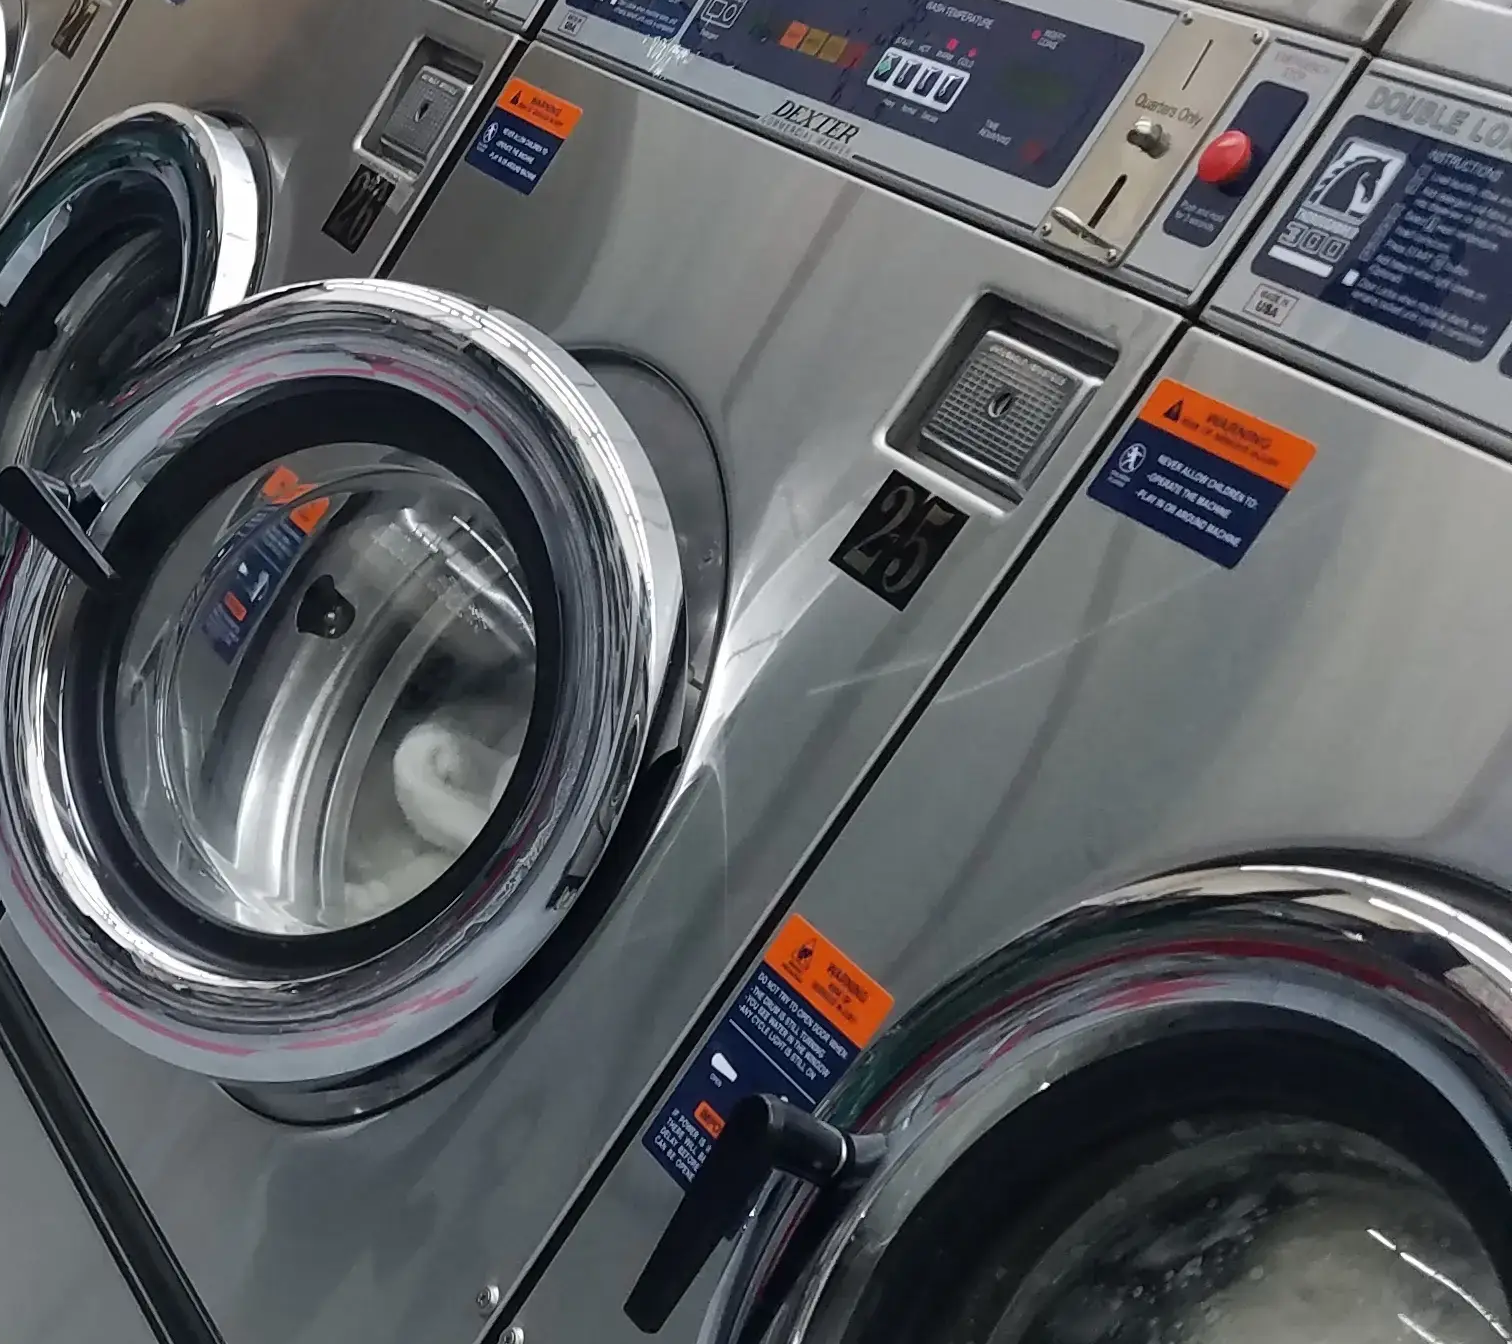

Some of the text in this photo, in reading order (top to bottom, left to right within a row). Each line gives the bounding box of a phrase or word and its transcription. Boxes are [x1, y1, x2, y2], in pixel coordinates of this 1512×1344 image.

[945, 6, 996, 30] TEMPERATURE
[771, 99, 861, 144] DEXTER
[1134, 92, 1204, 129] Quarters Only
[1366, 86, 1471, 136] DOUBLE
[1278, 220, 1351, 262] 300
[1180, 466, 1209, 485] ALLOW
[1181, 487, 1198, 502] THE
[842, 485, 956, 593] 25
[1205, 523, 1242, 547] MACHINE
[758, 972, 768, 984] DO
[767, 980, 780, 994] NOT
[778, 990, 791, 1004] TRY
[789, 1001, 798, 1012] TO
[797, 1008, 814, 1027] OPEN
[811, 1022, 830, 1042] DOOR
[763, 996, 781, 1015] DRUM
[778, 1011, 787, 1021] IS
[785, 1017, 800, 1036] STILL
[751, 1014, 770, 1036] CYCLE
[768, 1031, 787, 1051] LIGHT
[789, 1052, 806, 1073] STILL
[805, 1067, 817, 1081] ON
[757, 1006, 771, 1021] SEE
[768, 1016, 789, 1038] WATER
[793, 1040, 806, 1056] THE
[804, 1051, 831, 1078] WINDOW
[666, 1116, 686, 1140] THERE
[683, 1137, 699, 1155] WILL
[678, 1115, 700, 1140] POWER
[654, 1135, 668, 1151] CAN
[666, 1148, 677, 1161] BE
[660, 1126, 701, 1173] DELAY BEFORE
